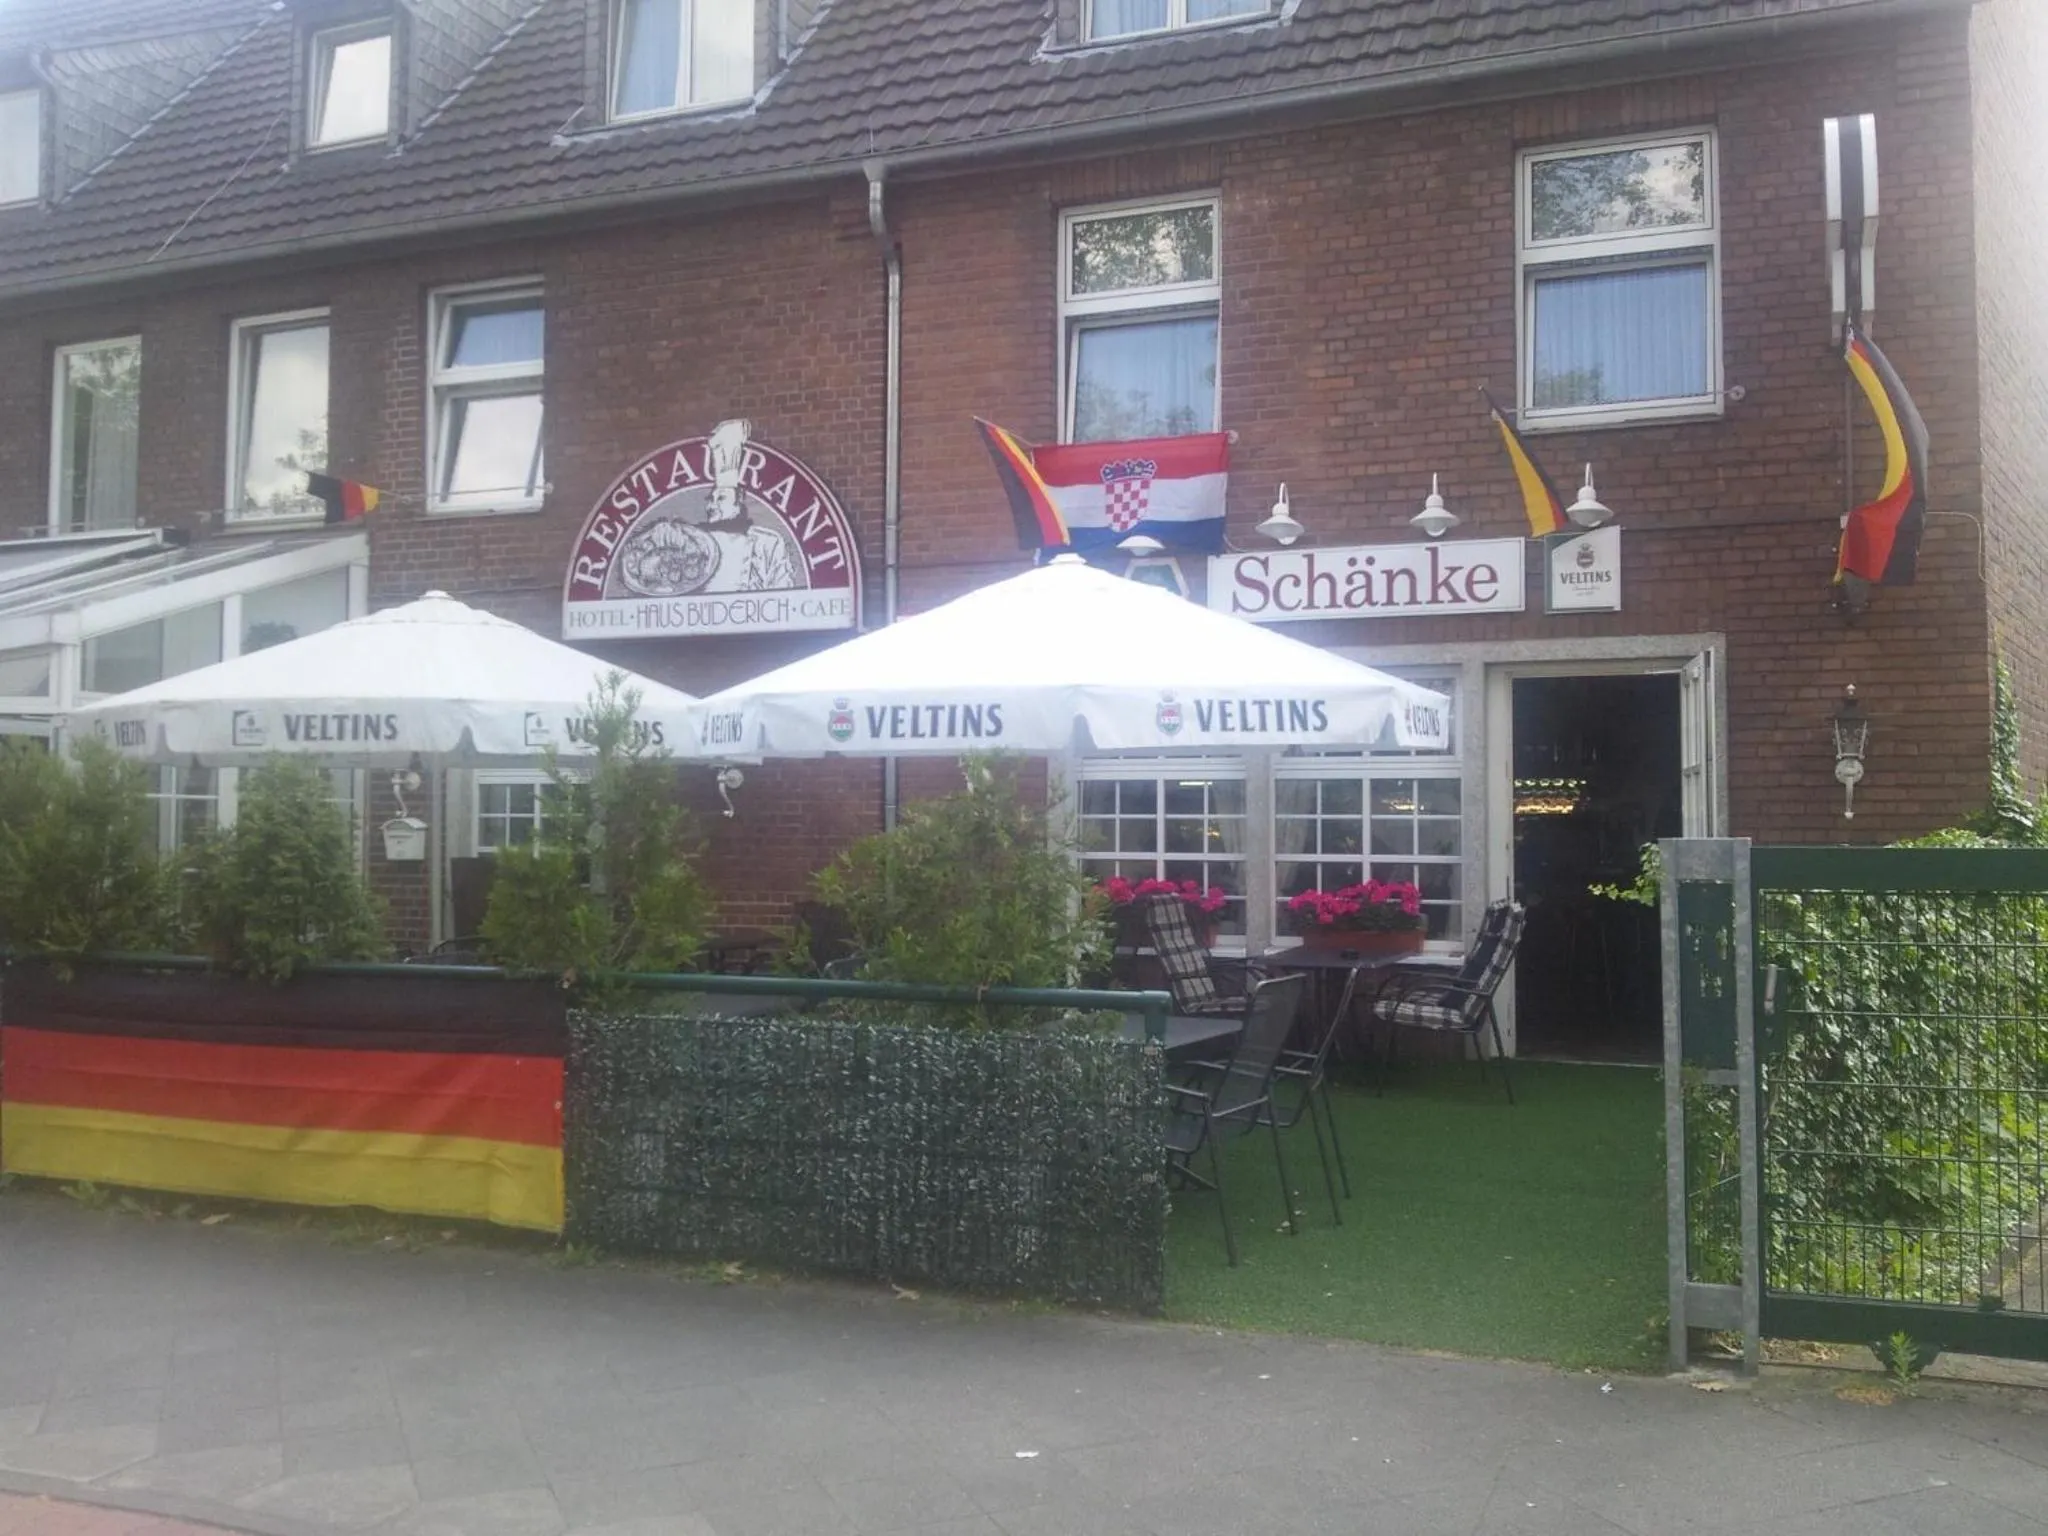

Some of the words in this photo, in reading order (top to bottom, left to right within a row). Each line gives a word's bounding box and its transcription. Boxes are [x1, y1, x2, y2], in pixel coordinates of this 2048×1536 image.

[571, 444, 845, 591] RESTAURANT
[1232, 547, 1500, 613] Schänke
[1560, 570, 1612, 585] VELTINS
[569, 609, 630, 628] HOTEL
[637, 602, 685, 629] HAUS
[283, 713, 399, 742] VELTINS
[564, 716, 664, 746] VENS
[865, 703, 1004, 739] VELTINS
[1193, 699, 1329, 733] VELTINS
